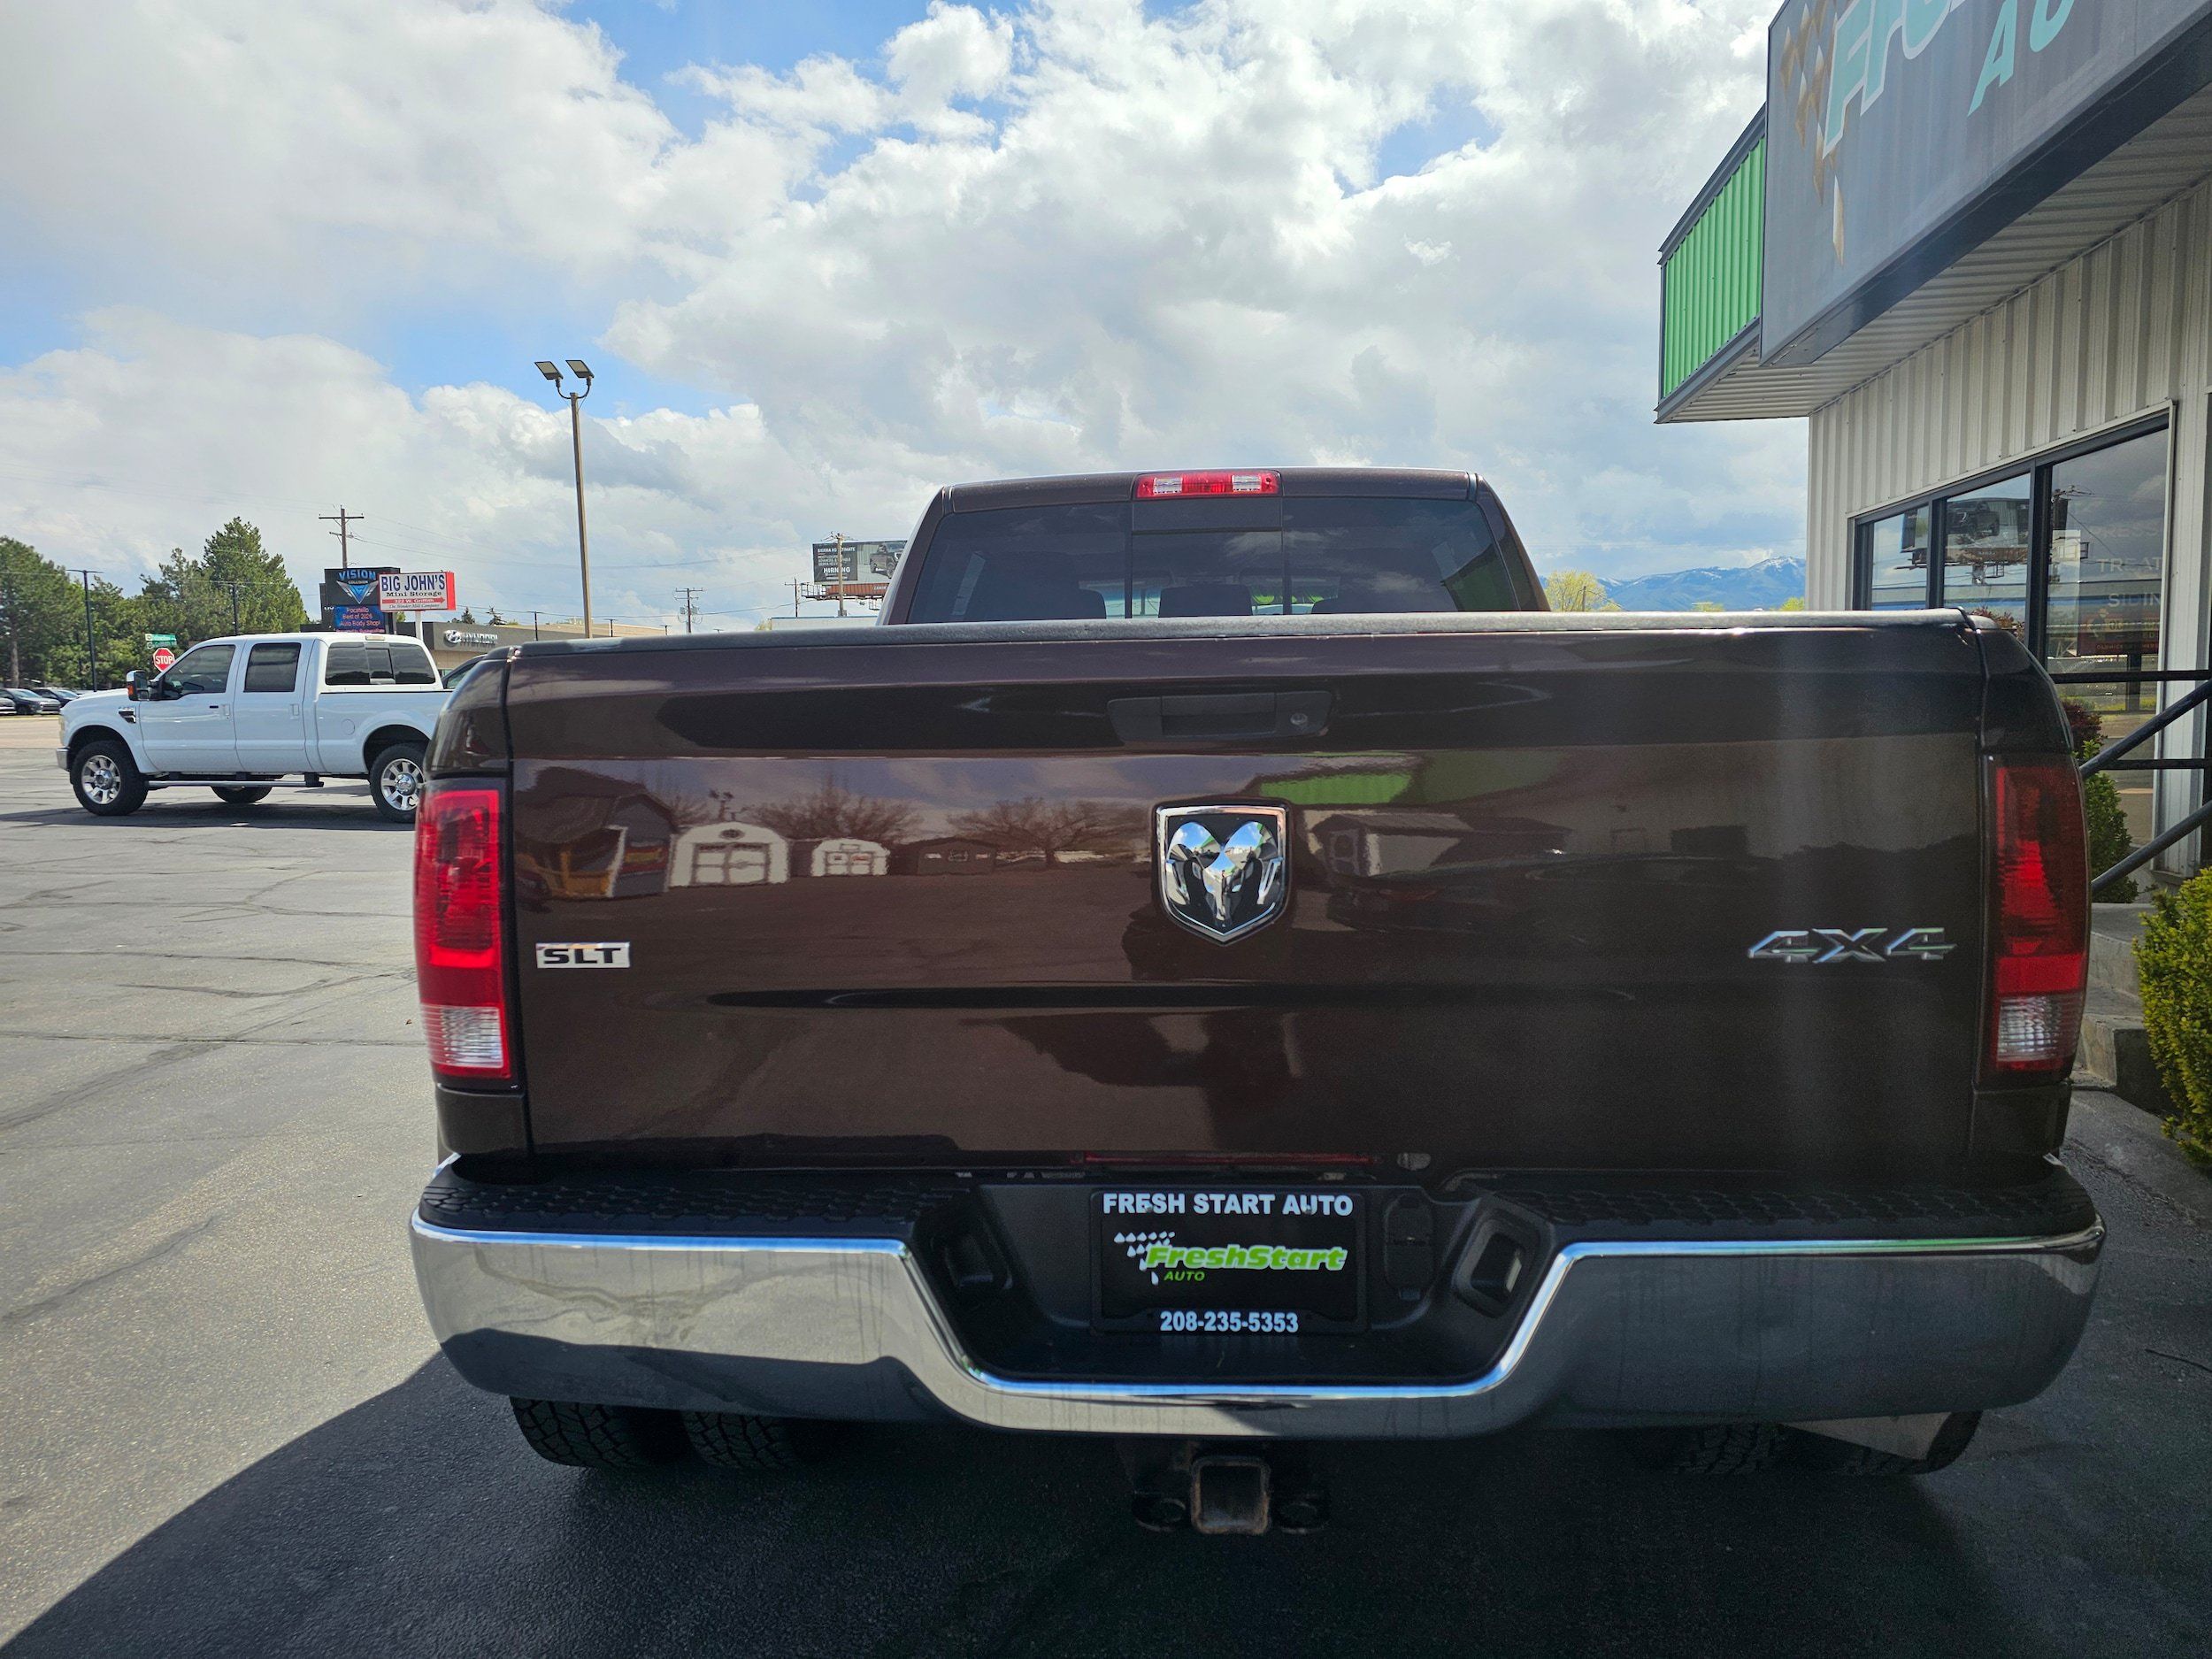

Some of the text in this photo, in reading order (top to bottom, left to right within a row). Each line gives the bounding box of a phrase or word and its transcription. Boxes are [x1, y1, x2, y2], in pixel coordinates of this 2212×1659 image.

[339, 569, 377, 581] VISION
[381, 574, 445, 592] BIG JOHN'S
[155, 655, 174, 664] STOP
[1748, 927, 1957, 964] 4X4
[543, 947, 622, 964] SLT
[1103, 1193, 1354, 1217] FRESH START AUTO
[1145, 1243, 1348, 1271] FreshStart
[1164, 1271, 1206, 1282] AUTO
[1159, 1310, 1299, 1333] 208-235-5353
